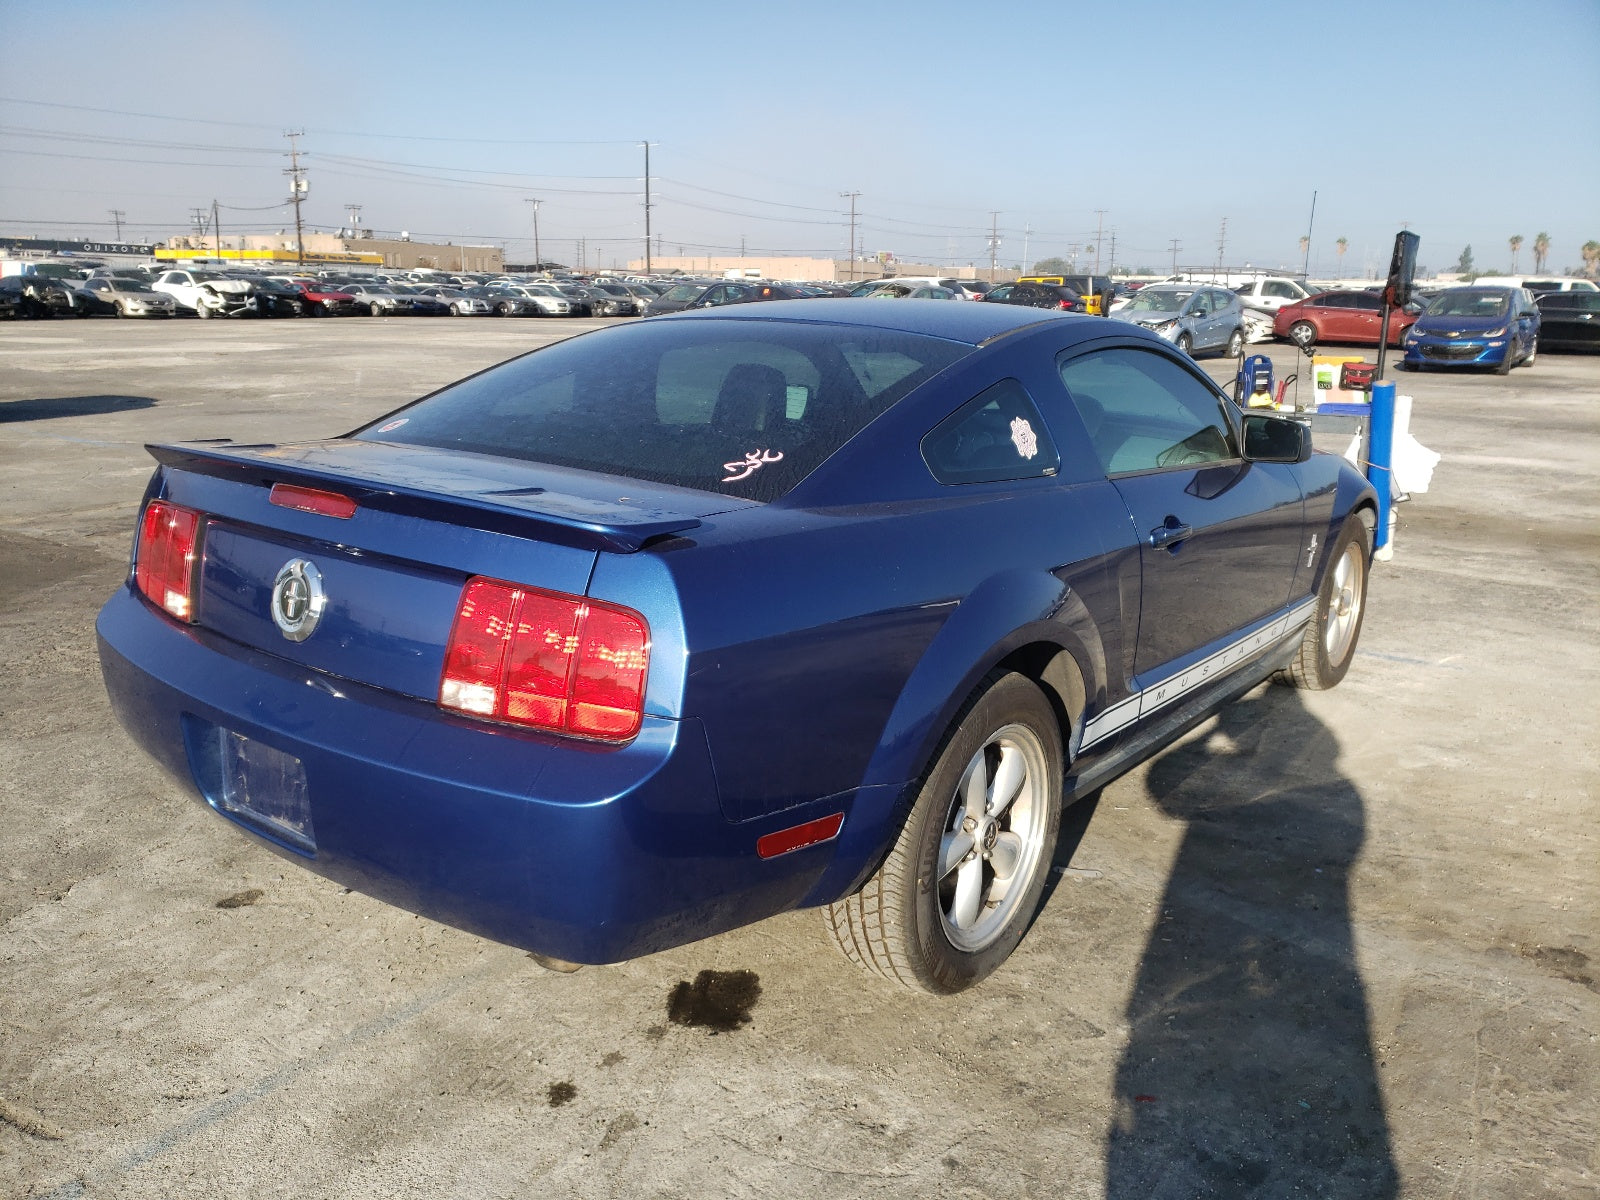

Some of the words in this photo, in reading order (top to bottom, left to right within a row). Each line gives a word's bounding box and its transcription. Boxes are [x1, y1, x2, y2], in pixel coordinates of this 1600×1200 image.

[83, 244, 148, 253] QUIXOTE
[1156, 628, 1278, 701] MUSTANG
[920, 799, 945, 895] KUMHO
